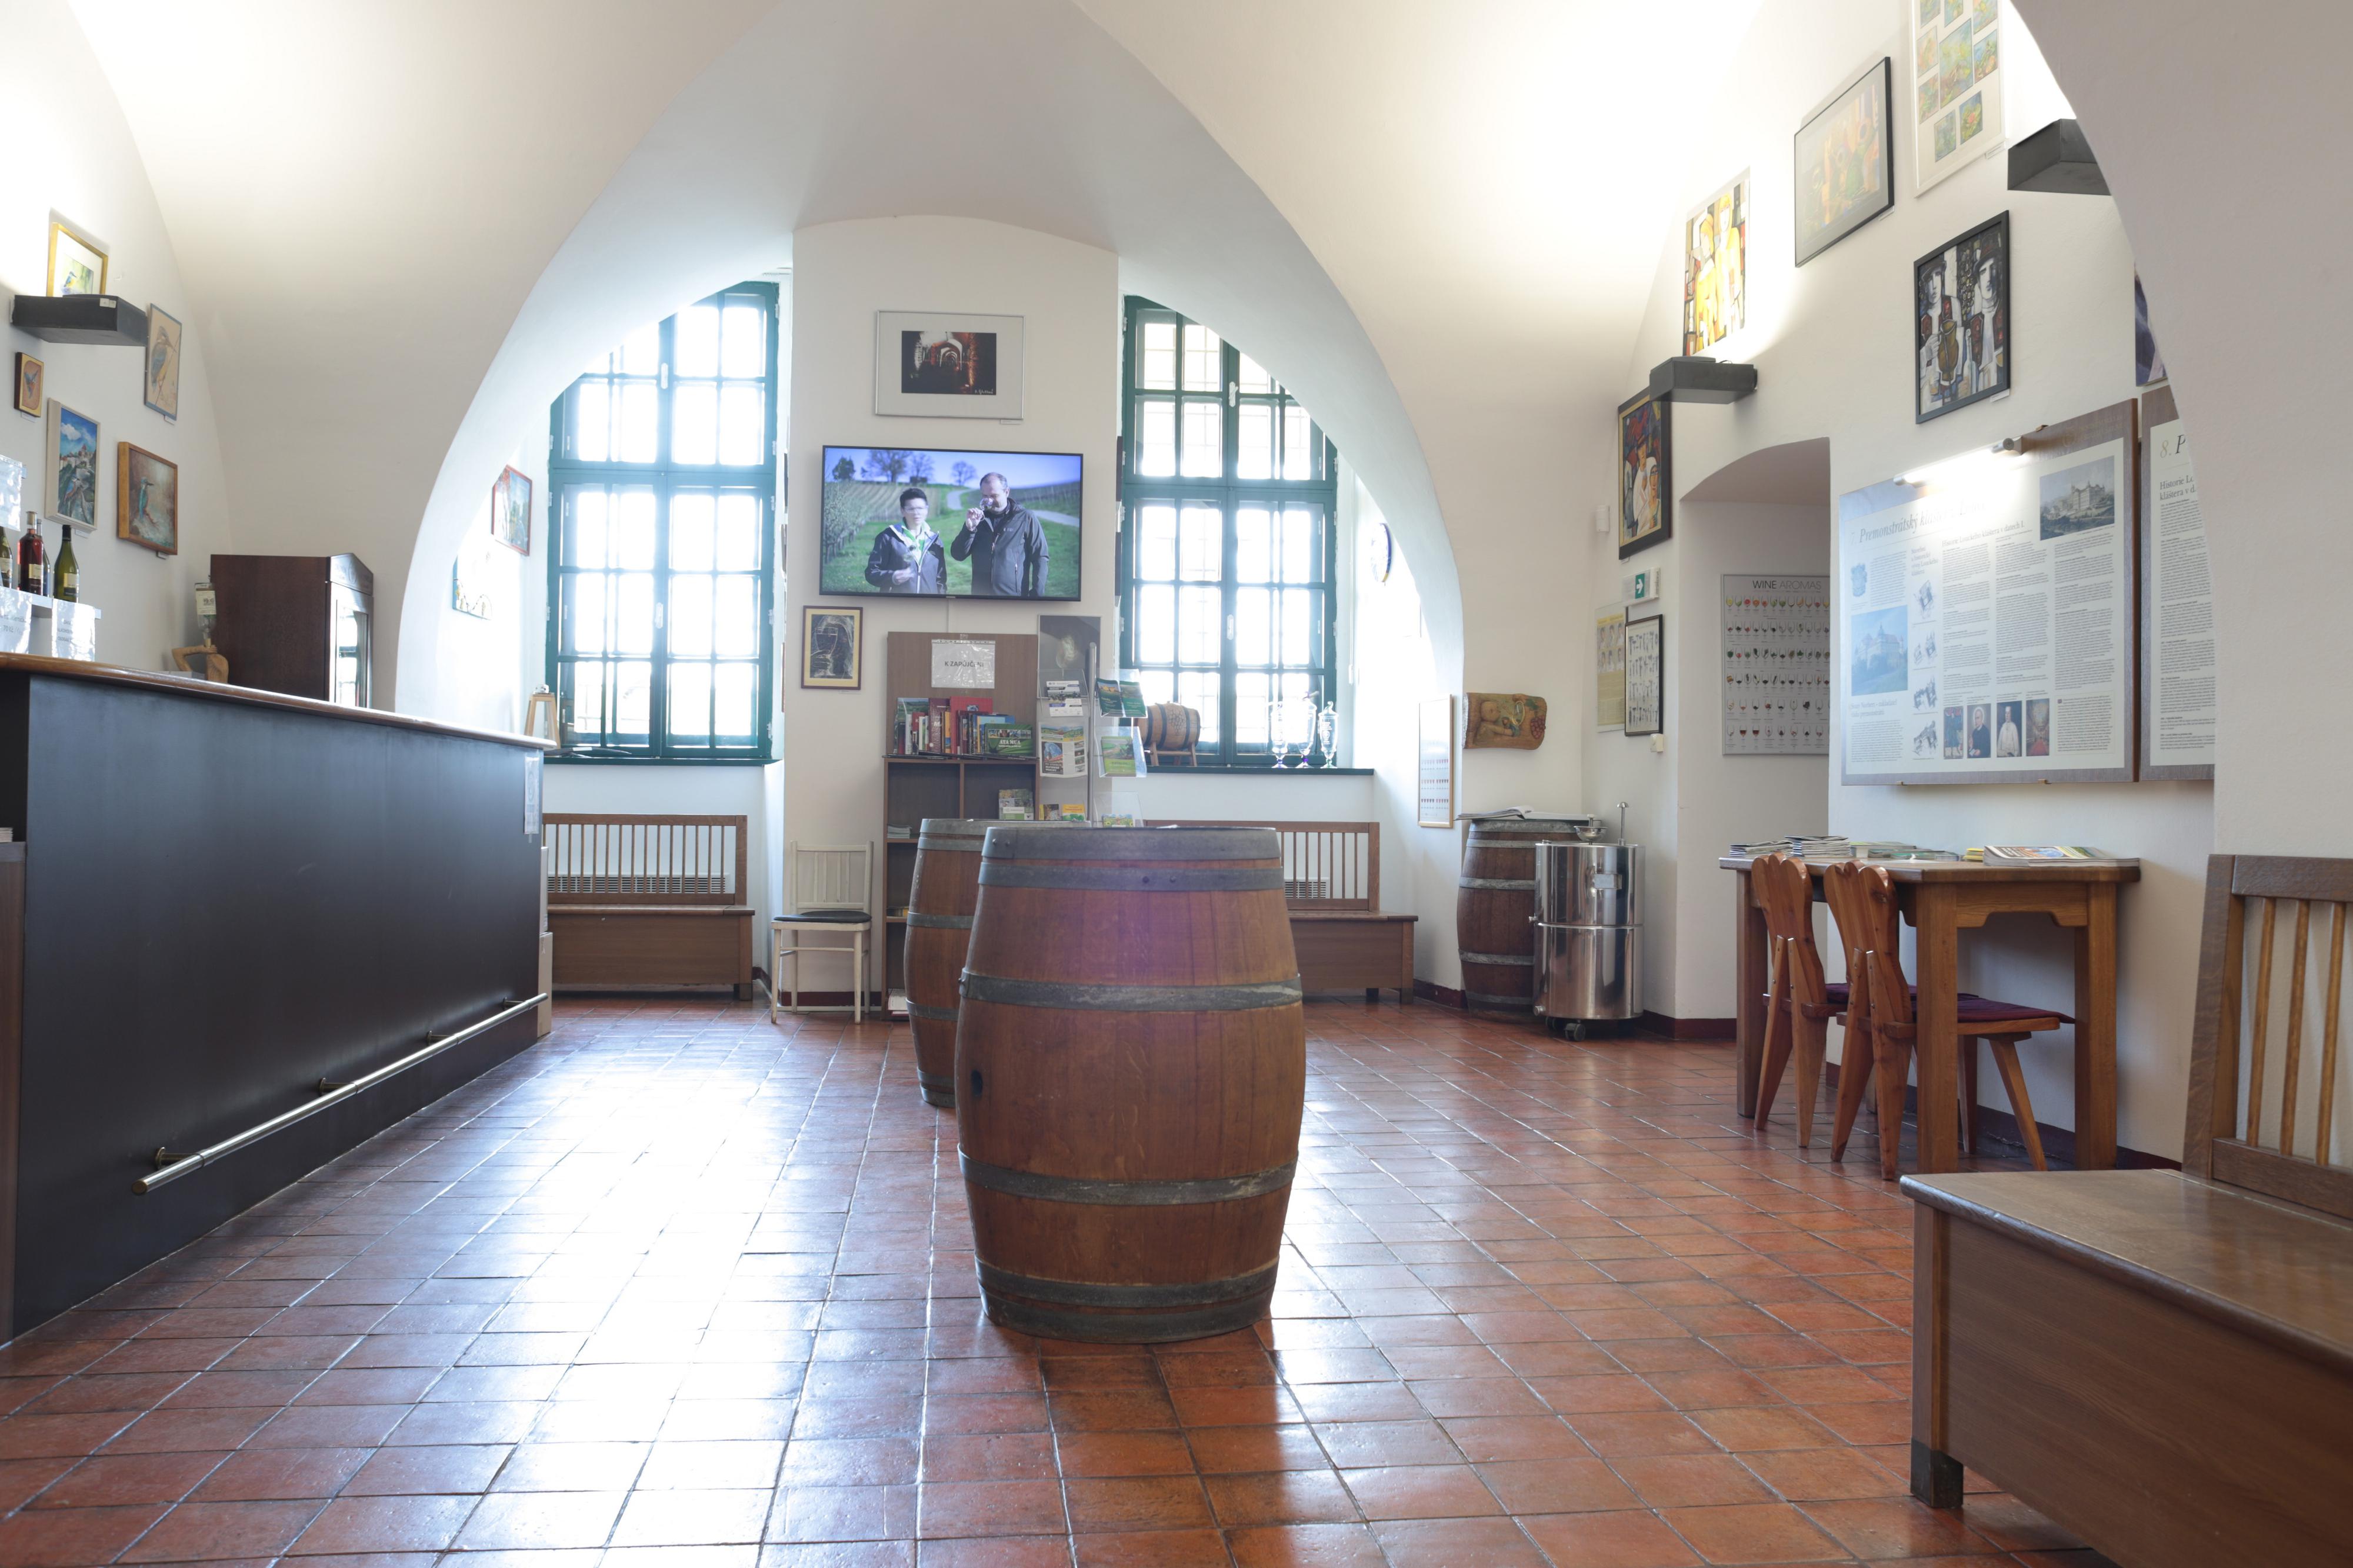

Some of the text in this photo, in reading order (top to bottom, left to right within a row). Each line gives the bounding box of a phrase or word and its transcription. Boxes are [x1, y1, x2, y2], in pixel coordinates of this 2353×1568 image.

[2160, 440, 2172, 458] 8.
[2159, 478, 2184, 490] Historie
[2159, 489, 2184, 501] kláštera
[1859, 513, 1919, 543] Premonstrátský
[1752, 580, 1822, 589] WINE AROMAS
